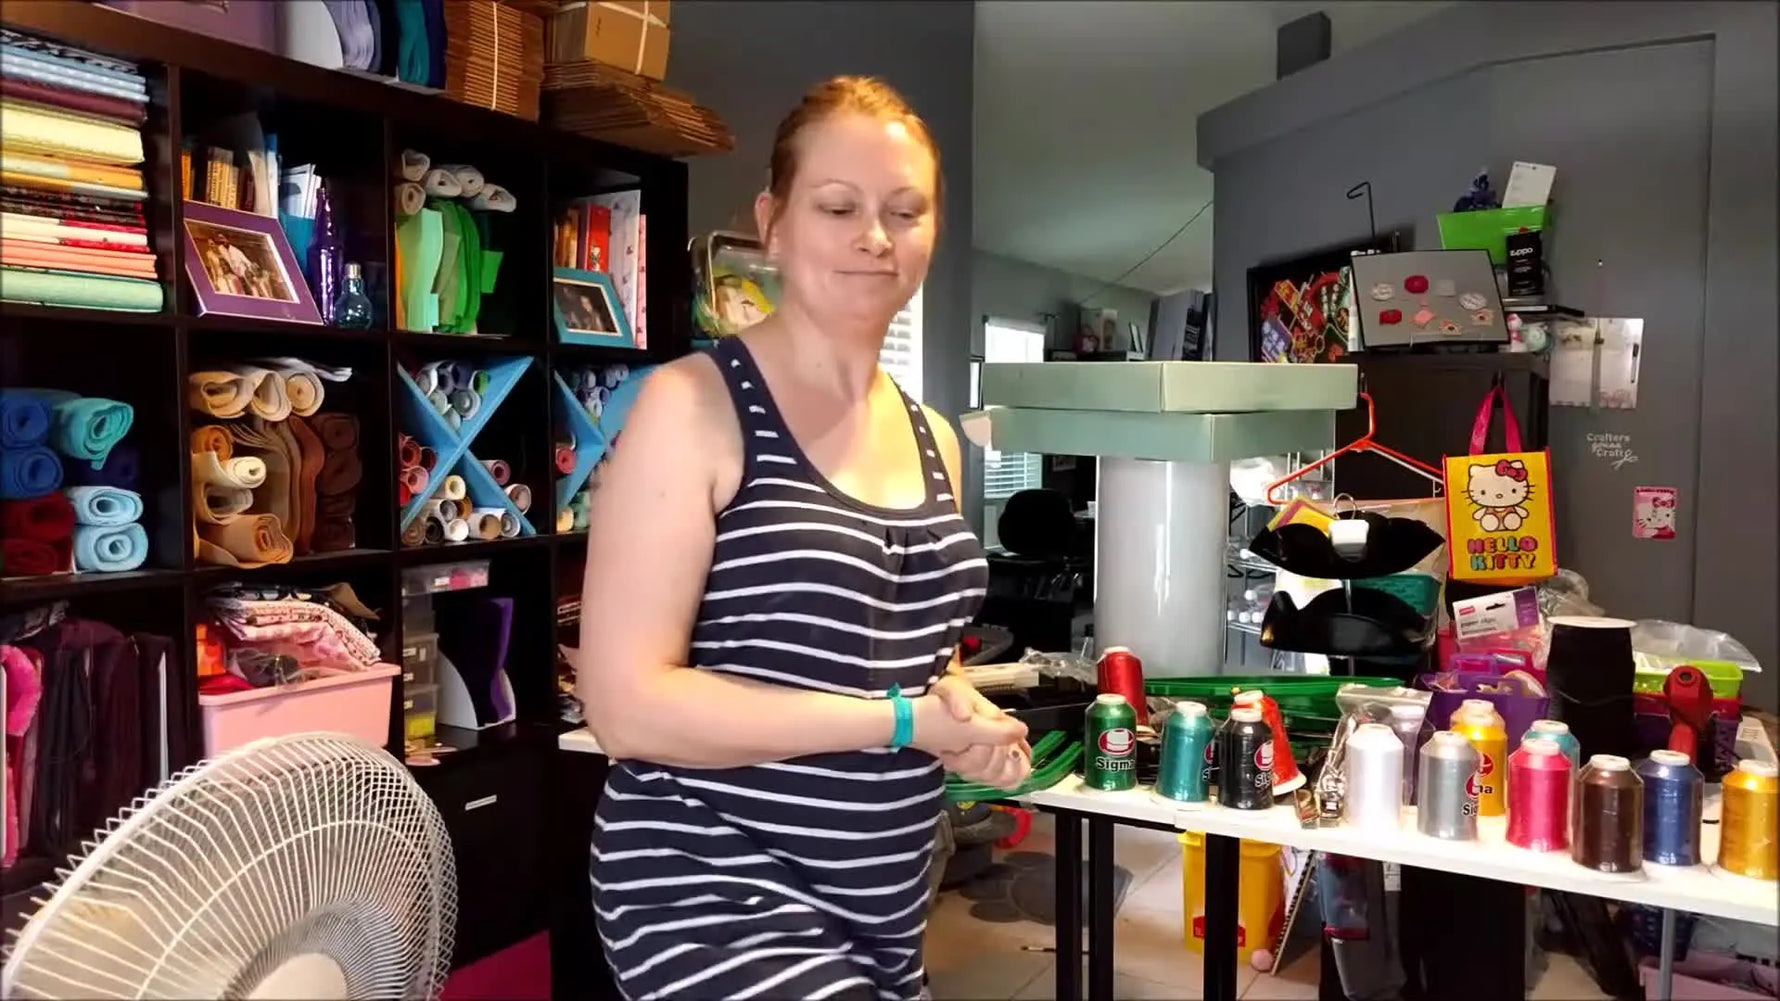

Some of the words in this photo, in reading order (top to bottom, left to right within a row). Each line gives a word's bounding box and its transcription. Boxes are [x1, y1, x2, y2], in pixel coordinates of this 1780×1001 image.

[1467, 536, 1538, 554] HELLO
[1470, 553, 1536, 571] KITTY
[1096, 756, 1136, 772] Sigma
